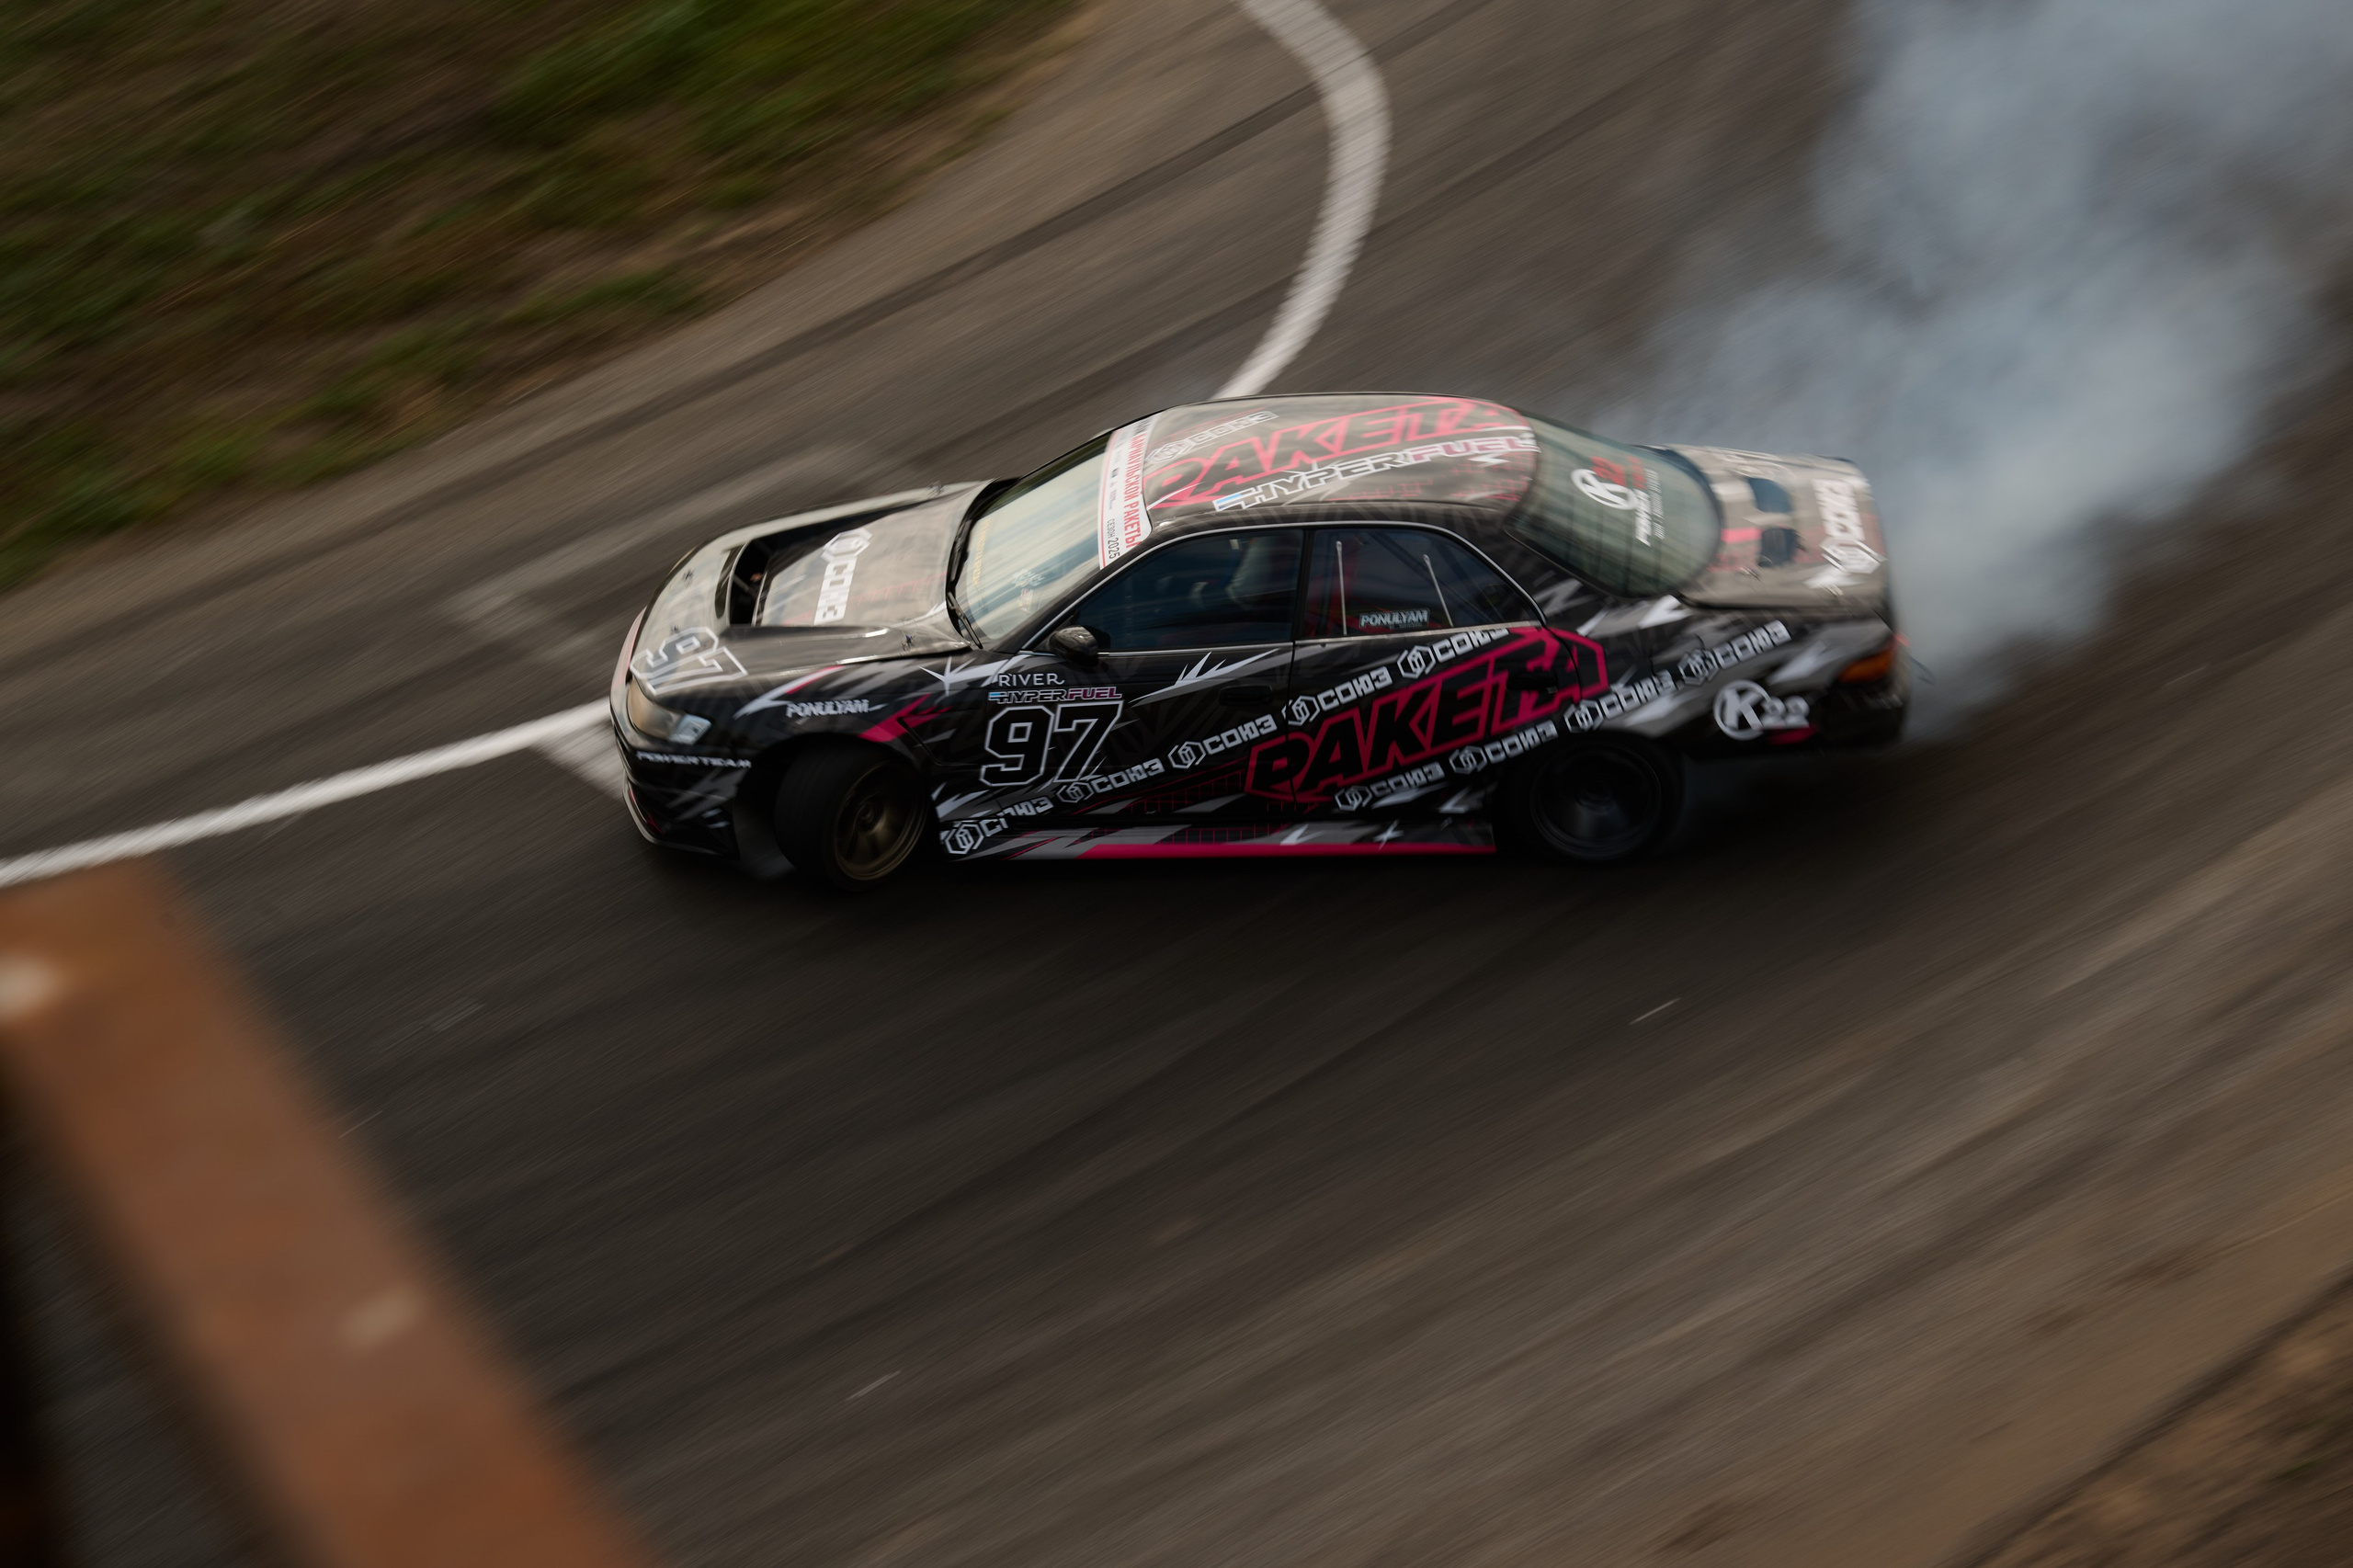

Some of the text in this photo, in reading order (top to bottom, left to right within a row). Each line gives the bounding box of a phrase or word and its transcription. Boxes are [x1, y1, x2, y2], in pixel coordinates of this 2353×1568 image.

[1108, 537, 1120, 560] 2025
[1359, 608, 1429, 629] PONULYAM
[630, 626, 748, 696] 97
[998, 673, 1065, 687] RIVER
[987, 686, 1123, 705] HYPERFUEL
[1091, 757, 1165, 793] СОЮЗ
[1202, 713, 1278, 756] СОЮЗ
[1317, 666, 1393, 711] СОЮЗ
[979, 699, 1124, 787] 97
